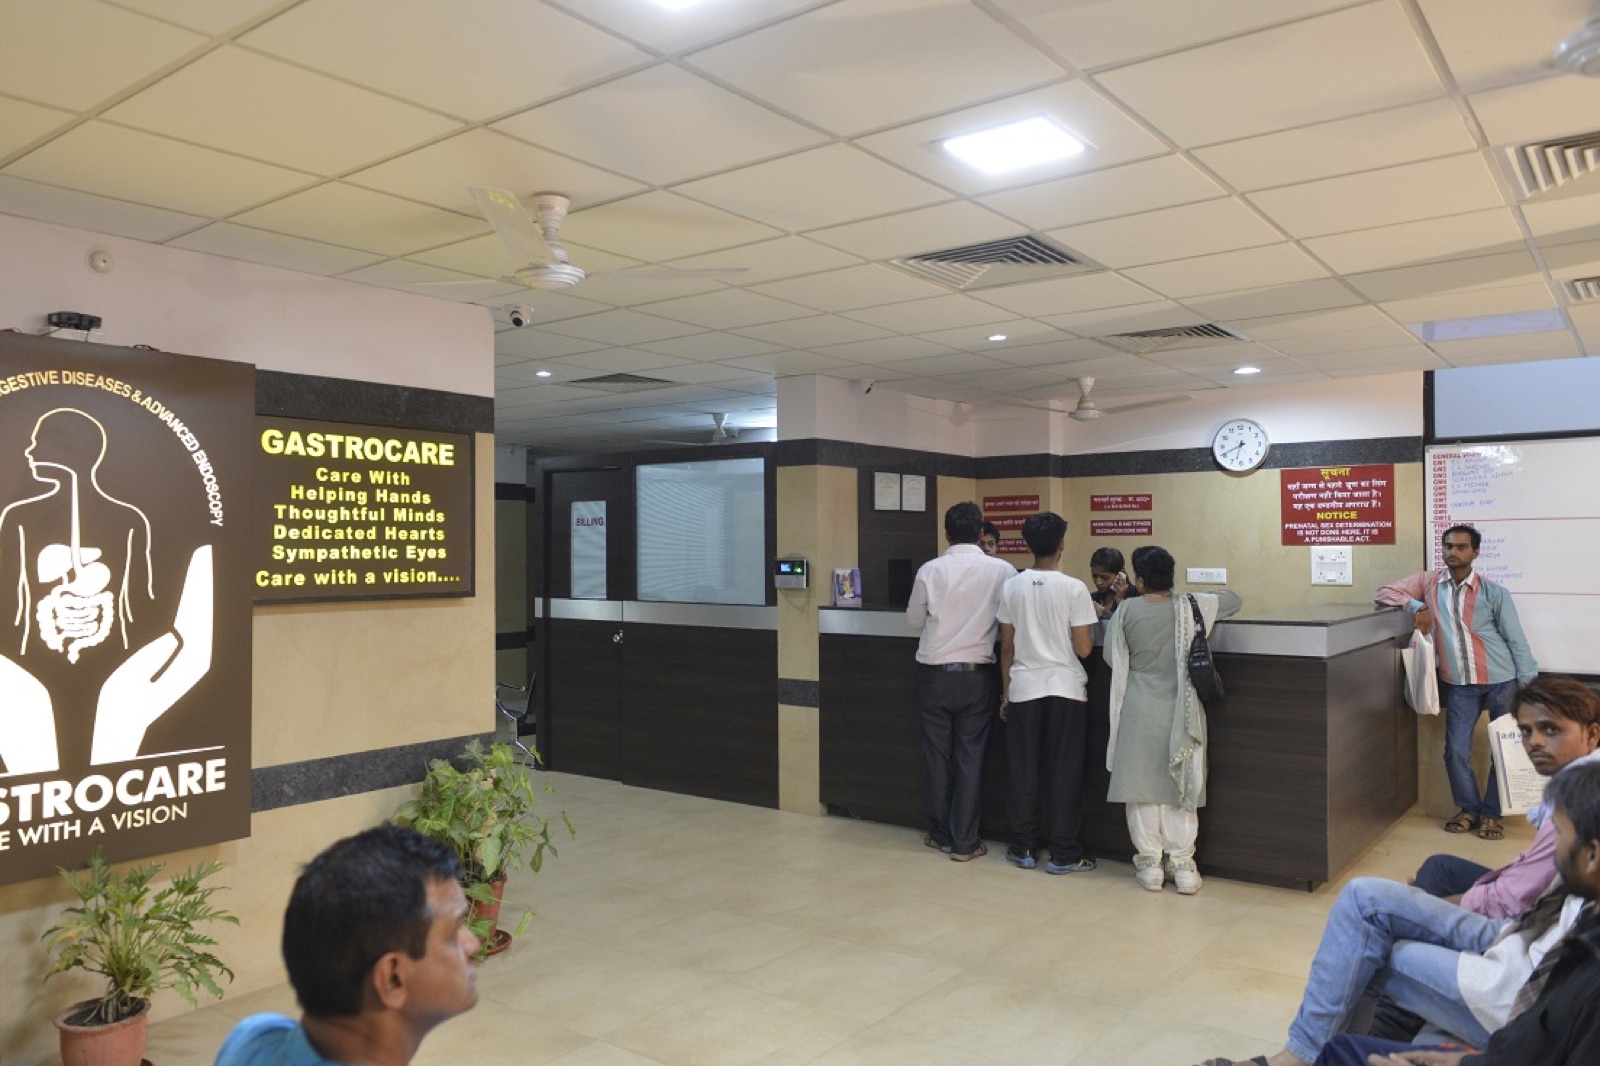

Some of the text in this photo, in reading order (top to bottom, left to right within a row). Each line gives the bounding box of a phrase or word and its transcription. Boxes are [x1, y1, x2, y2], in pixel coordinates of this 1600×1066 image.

[0, 370, 224, 526] GESTIVE DISEASES & ADVANCED ENDOSCOPY
[261, 429, 455, 466] GASTROCARE
[316, 467, 410, 486] Care With
[1321, 468, 1351, 480] सूचना
[291, 485, 431, 506] Helping Hands
[274, 504, 445, 524] Thoughtful Minds
[576, 516, 604, 526] BILLING
[1316, 511, 1358, 520] NOTICE
[273, 524, 445, 541] Dedicated Hearts
[272, 544, 447, 563] Sympathetic Eyes
[256, 570, 306, 587] Care
[314, 569, 357, 585] with
[365, 573, 376, 584] a
[0, 758, 226, 826] STROCARE
[17, 820, 81, 846] WITH
[88, 817, 106, 836] A
[112, 802, 187, 830] VISION
